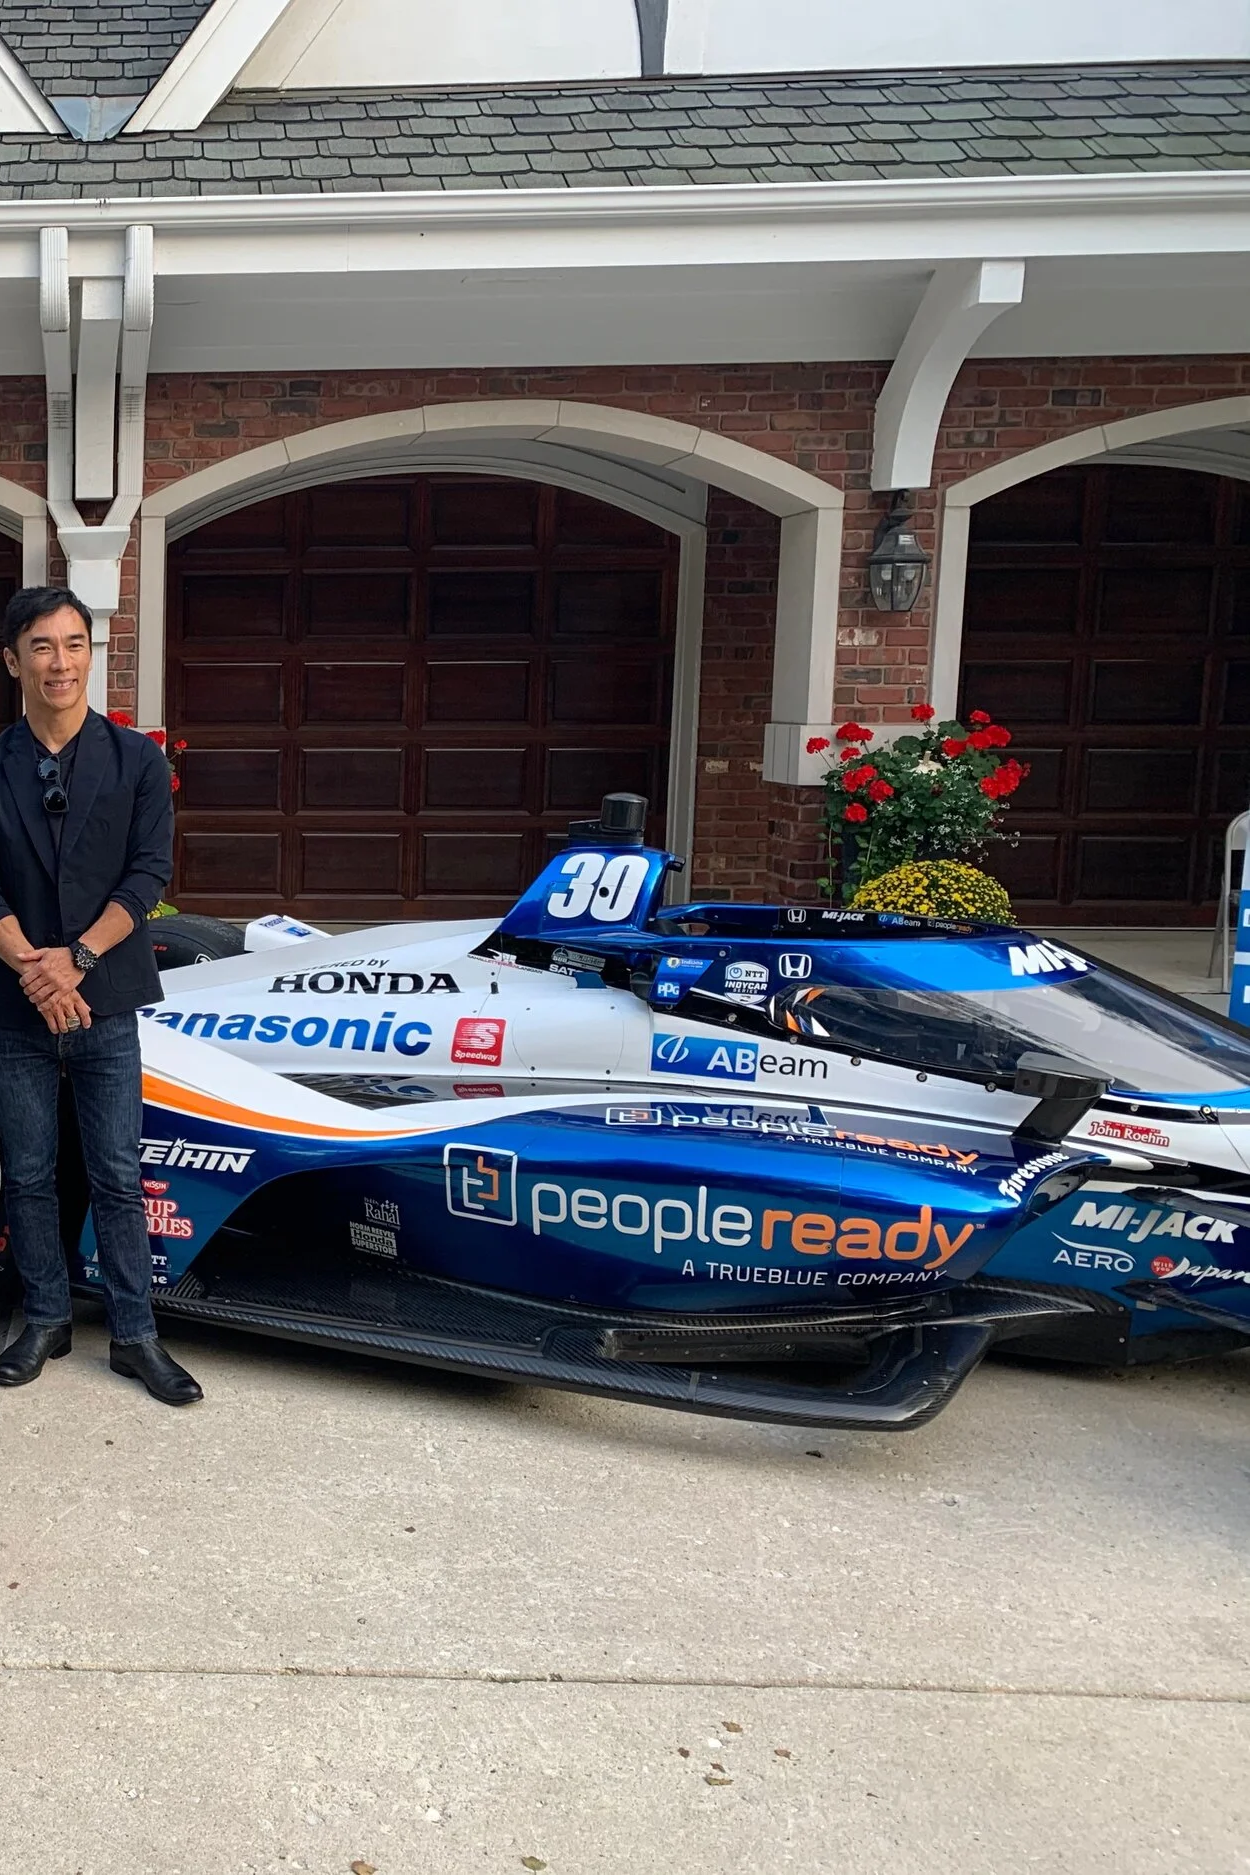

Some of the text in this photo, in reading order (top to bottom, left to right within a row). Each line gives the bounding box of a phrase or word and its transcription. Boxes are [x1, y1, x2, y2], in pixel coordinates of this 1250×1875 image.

[547, 853, 650, 922] 30
[822, 911, 865, 922] MI-JACK
[891, 917, 921, 927] ABeam
[366, 958, 390, 968] by
[549, 963, 583, 976] SAT
[1008, 940, 1088, 976] MI-J
[268, 971, 461, 994] HONDA
[725, 980, 768, 991] INDYCAR
[744, 970, 765, 979] NTT
[657, 983, 680, 997] PPG
[454, 1049, 499, 1062] Speedway
[707, 1046, 828, 1079] ABeam
[1090, 1121, 1121, 1138] John
[1124, 1127, 1170, 1147] Roehm
[139, 1140, 254, 1174] EIHIN
[803, 1137, 890, 1156] TRUEBLUE
[896, 1151, 979, 1176] COMPANY
[143, 1180, 168, 1190] NISSIN
[998, 1151, 1071, 1202] Firestone
[364, 1201, 401, 1226] Rahal
[1071, 1201, 1240, 1244] MI-JACK
[353, 1229, 394, 1247] Honda
[531, 1183, 975, 1270] peopleready
[351, 1237, 398, 1256] SUPERSTORE
[681, 1259, 948, 1286] A TRUEBLUE COMPANY
[1053, 1249, 1134, 1273] AERO
[1153, 1260, 1174, 1269] With
